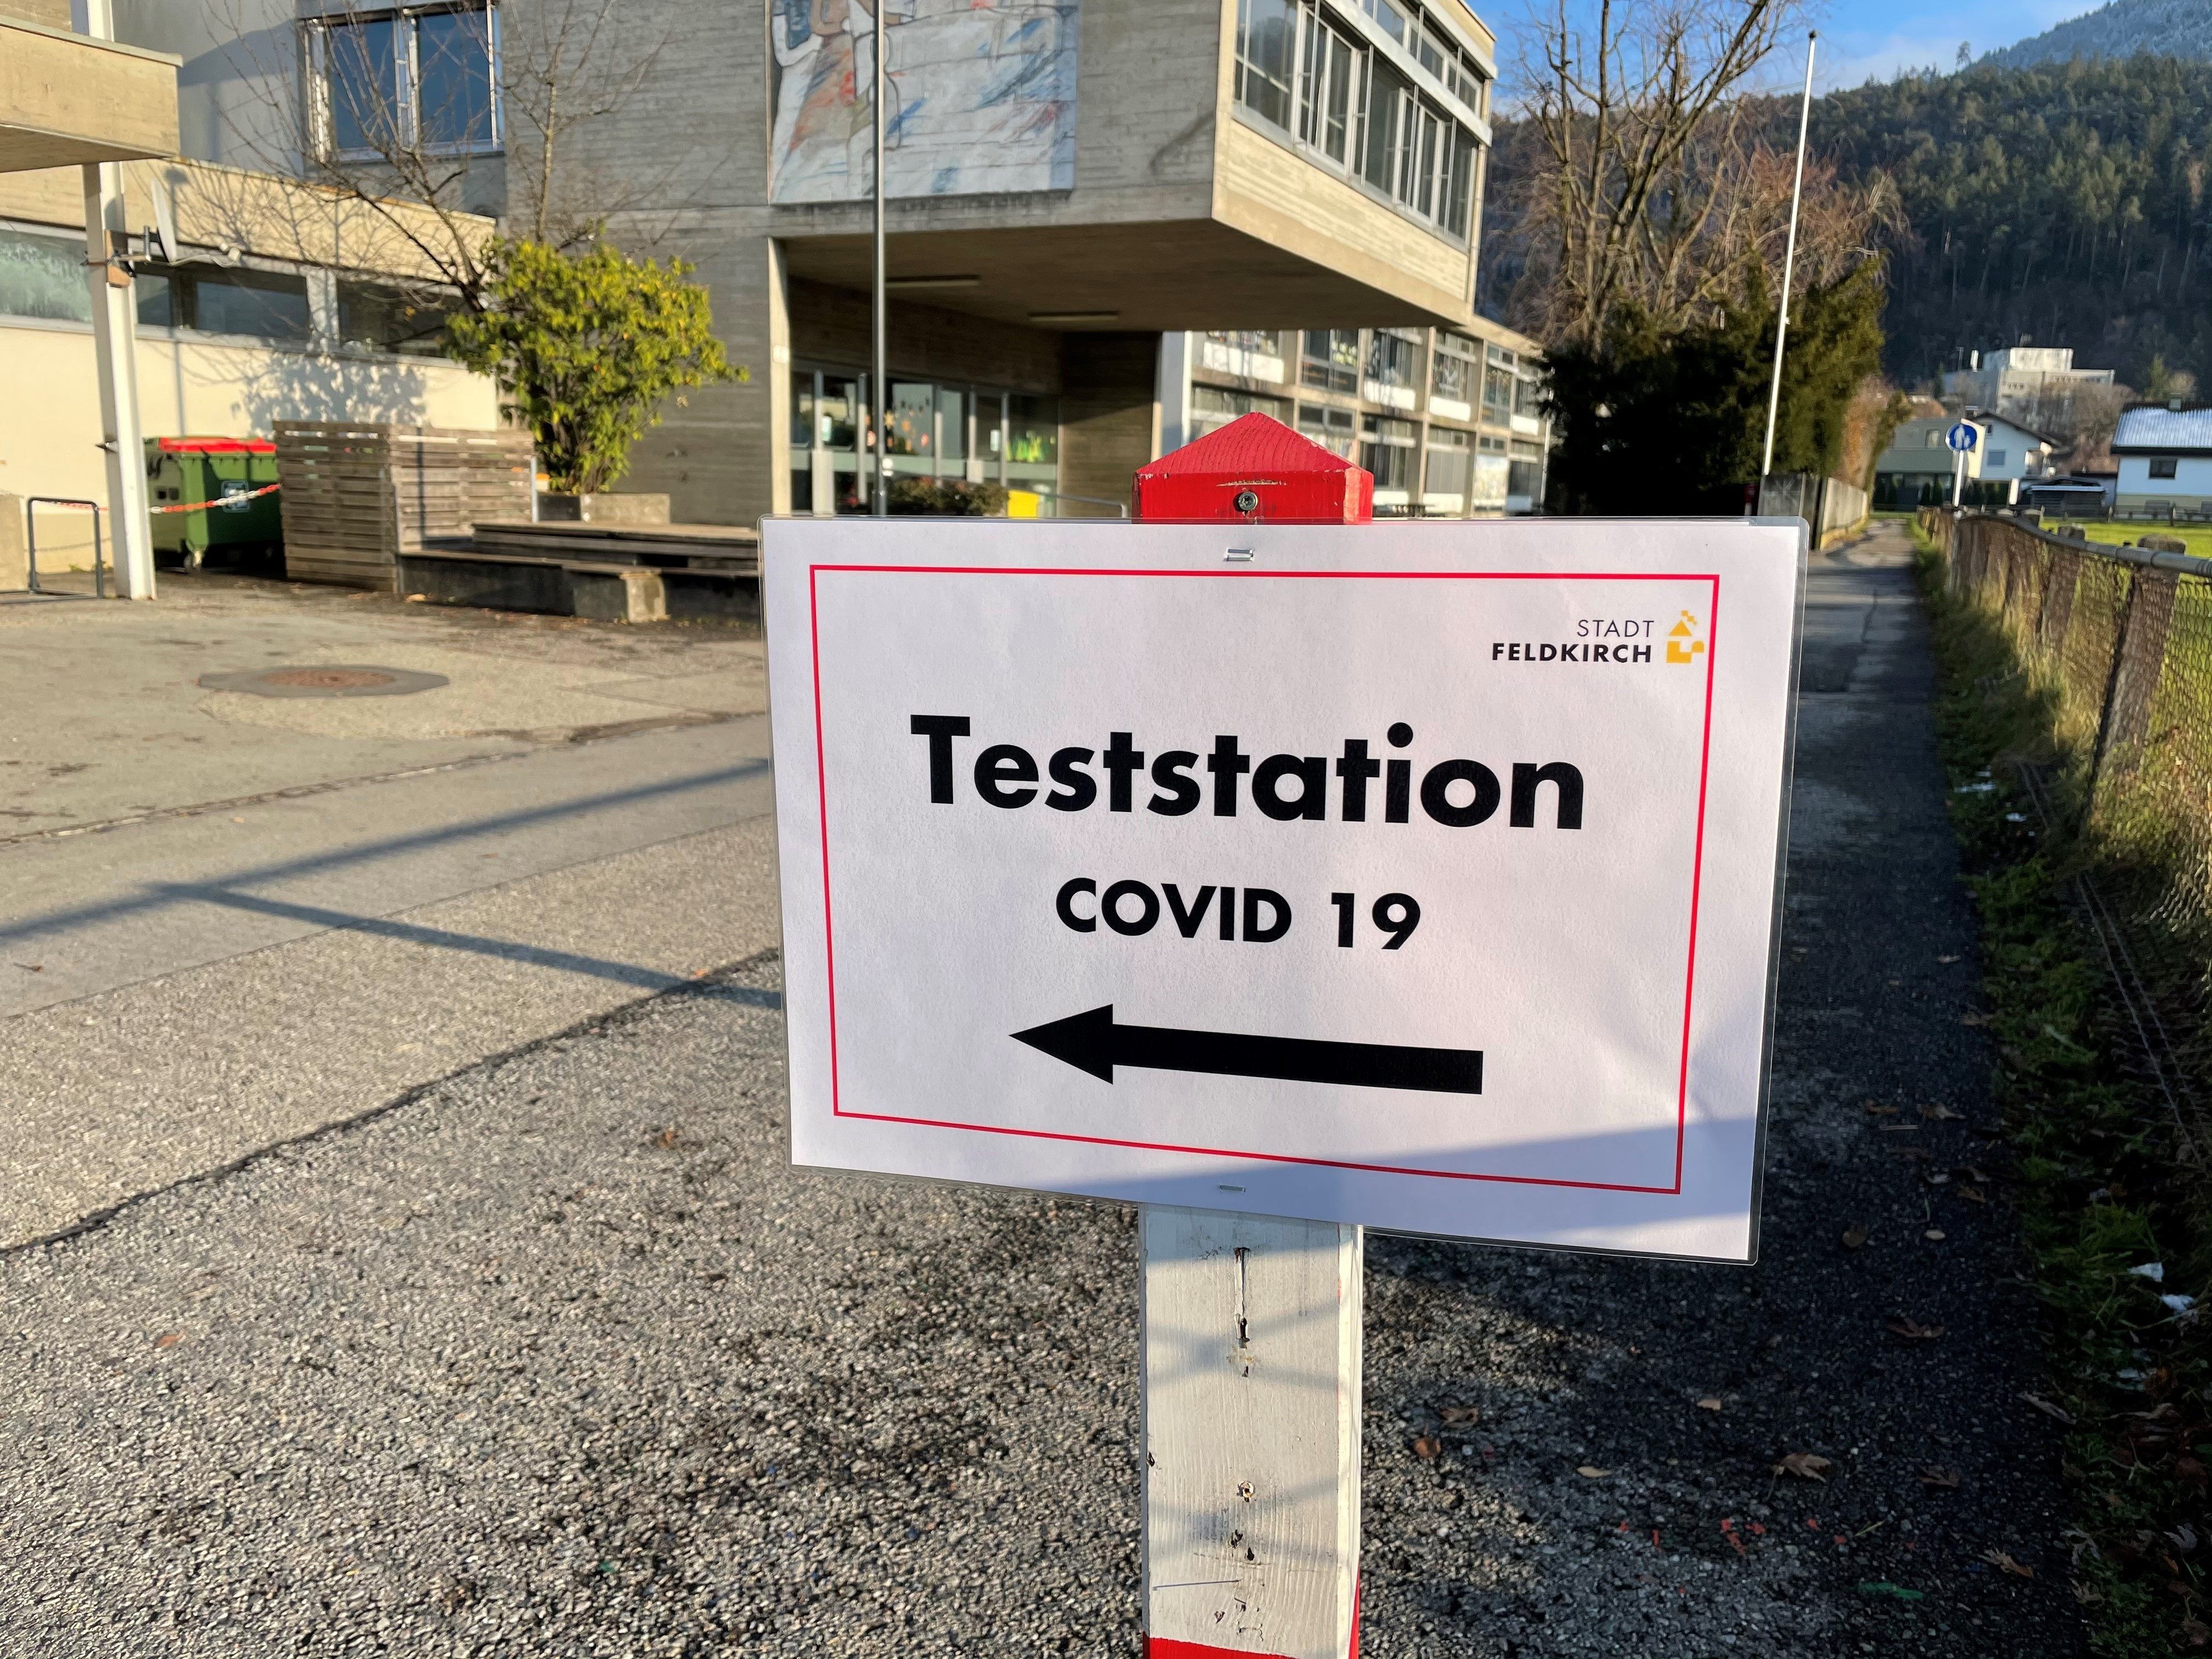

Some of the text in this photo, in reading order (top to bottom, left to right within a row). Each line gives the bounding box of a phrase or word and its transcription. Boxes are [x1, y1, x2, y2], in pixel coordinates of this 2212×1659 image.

[1576, 619, 1655, 638] STADT
[1492, 642, 1652, 663] FELDKIRCH
[910, 714, 1584, 830] Teststation
[1056, 877, 1421, 950] COVID 19
